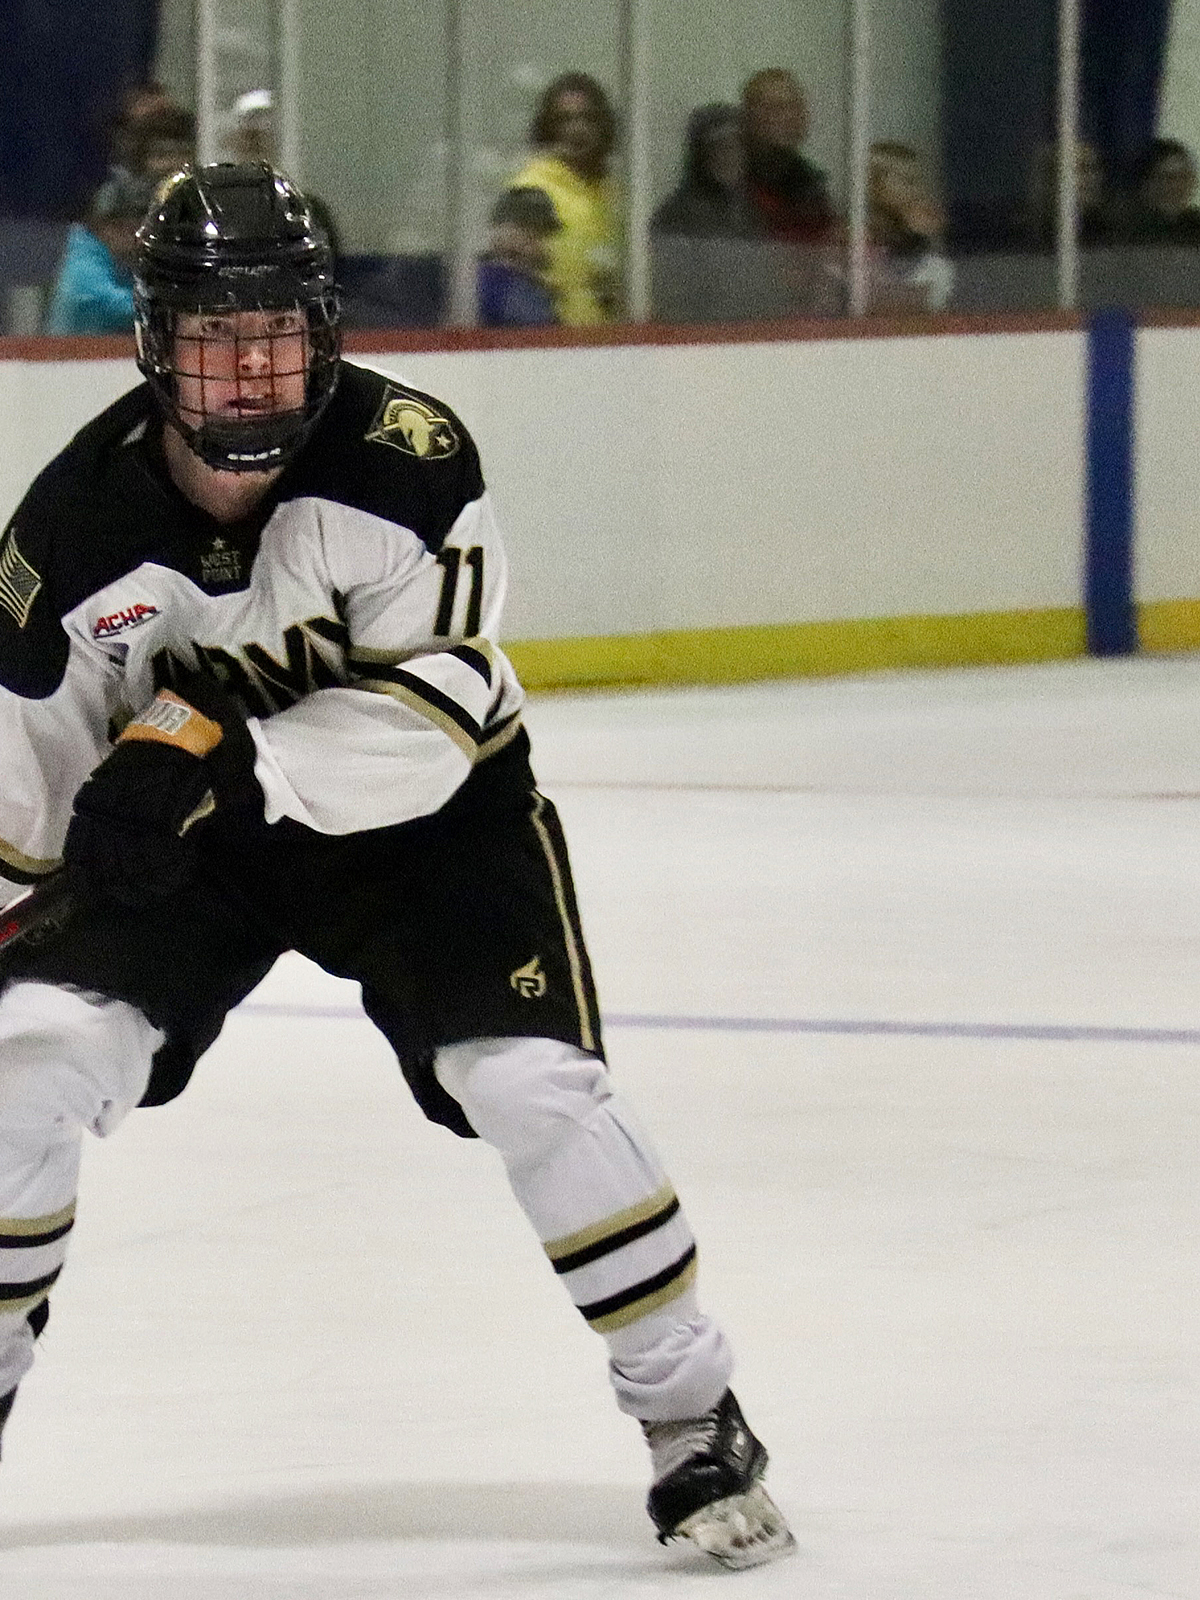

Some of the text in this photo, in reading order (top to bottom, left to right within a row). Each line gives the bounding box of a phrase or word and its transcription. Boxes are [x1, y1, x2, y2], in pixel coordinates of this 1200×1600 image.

[200, 550, 240, 568] WEST
[433, 547, 484, 637] 11
[93, 603, 157, 636] ACHA
